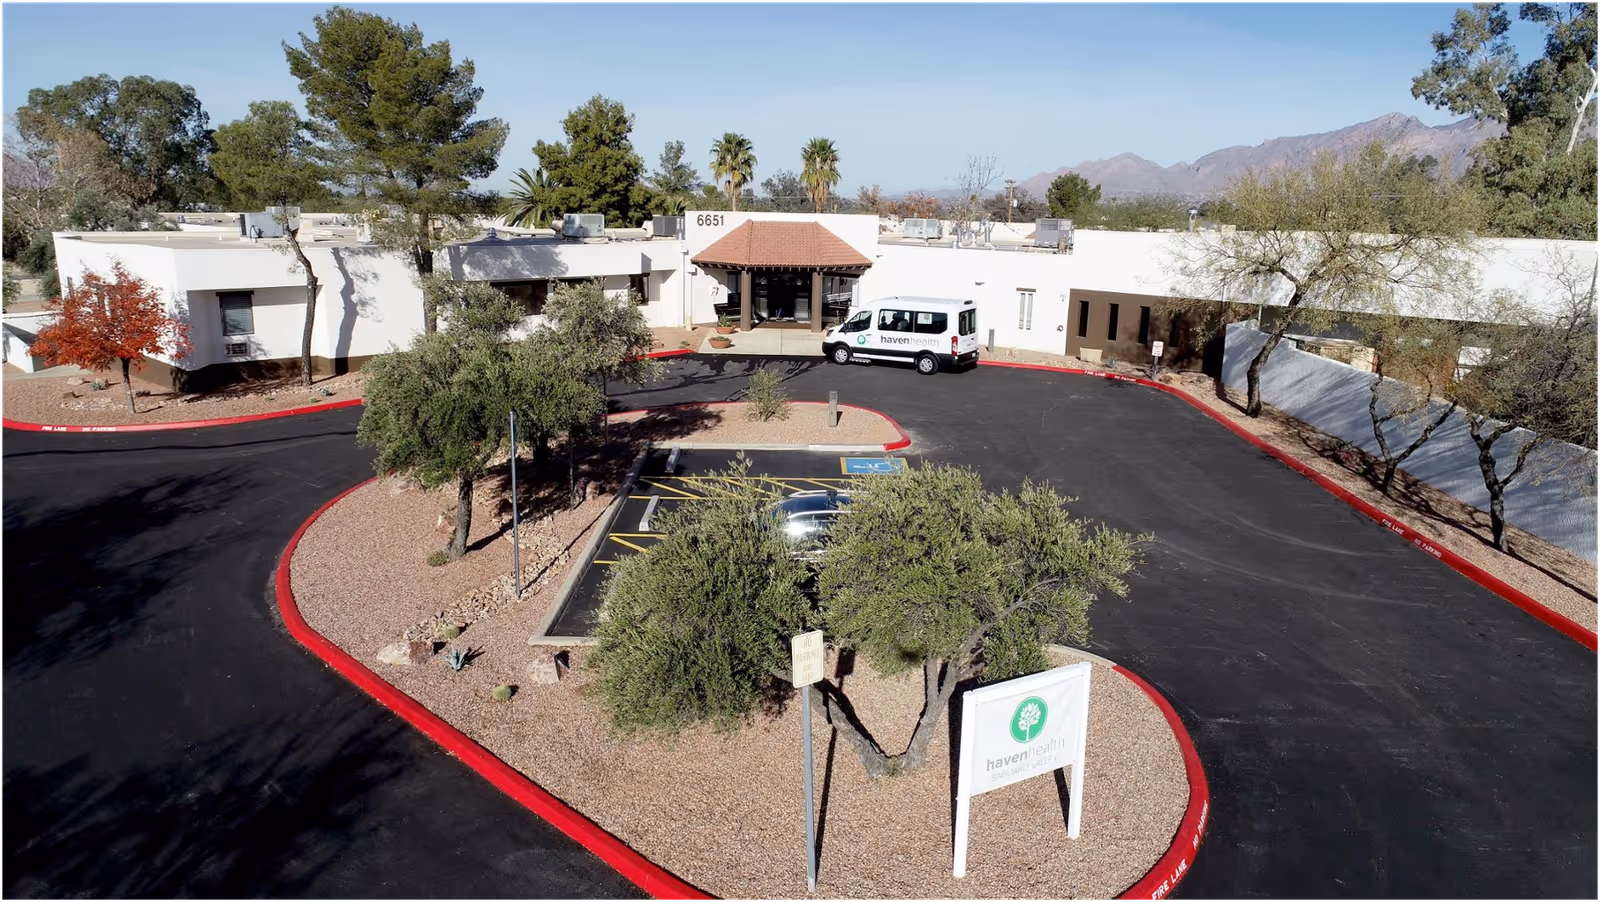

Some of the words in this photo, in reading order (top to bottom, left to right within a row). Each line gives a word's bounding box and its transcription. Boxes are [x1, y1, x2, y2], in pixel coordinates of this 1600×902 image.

[696, 213, 724, 227] 6651
[880, 334, 940, 348] havenhealth
[985, 735, 1065, 772] havenhealth
[1151, 880, 1170, 900] FIRE
[1170, 858, 1188, 884] LANE
